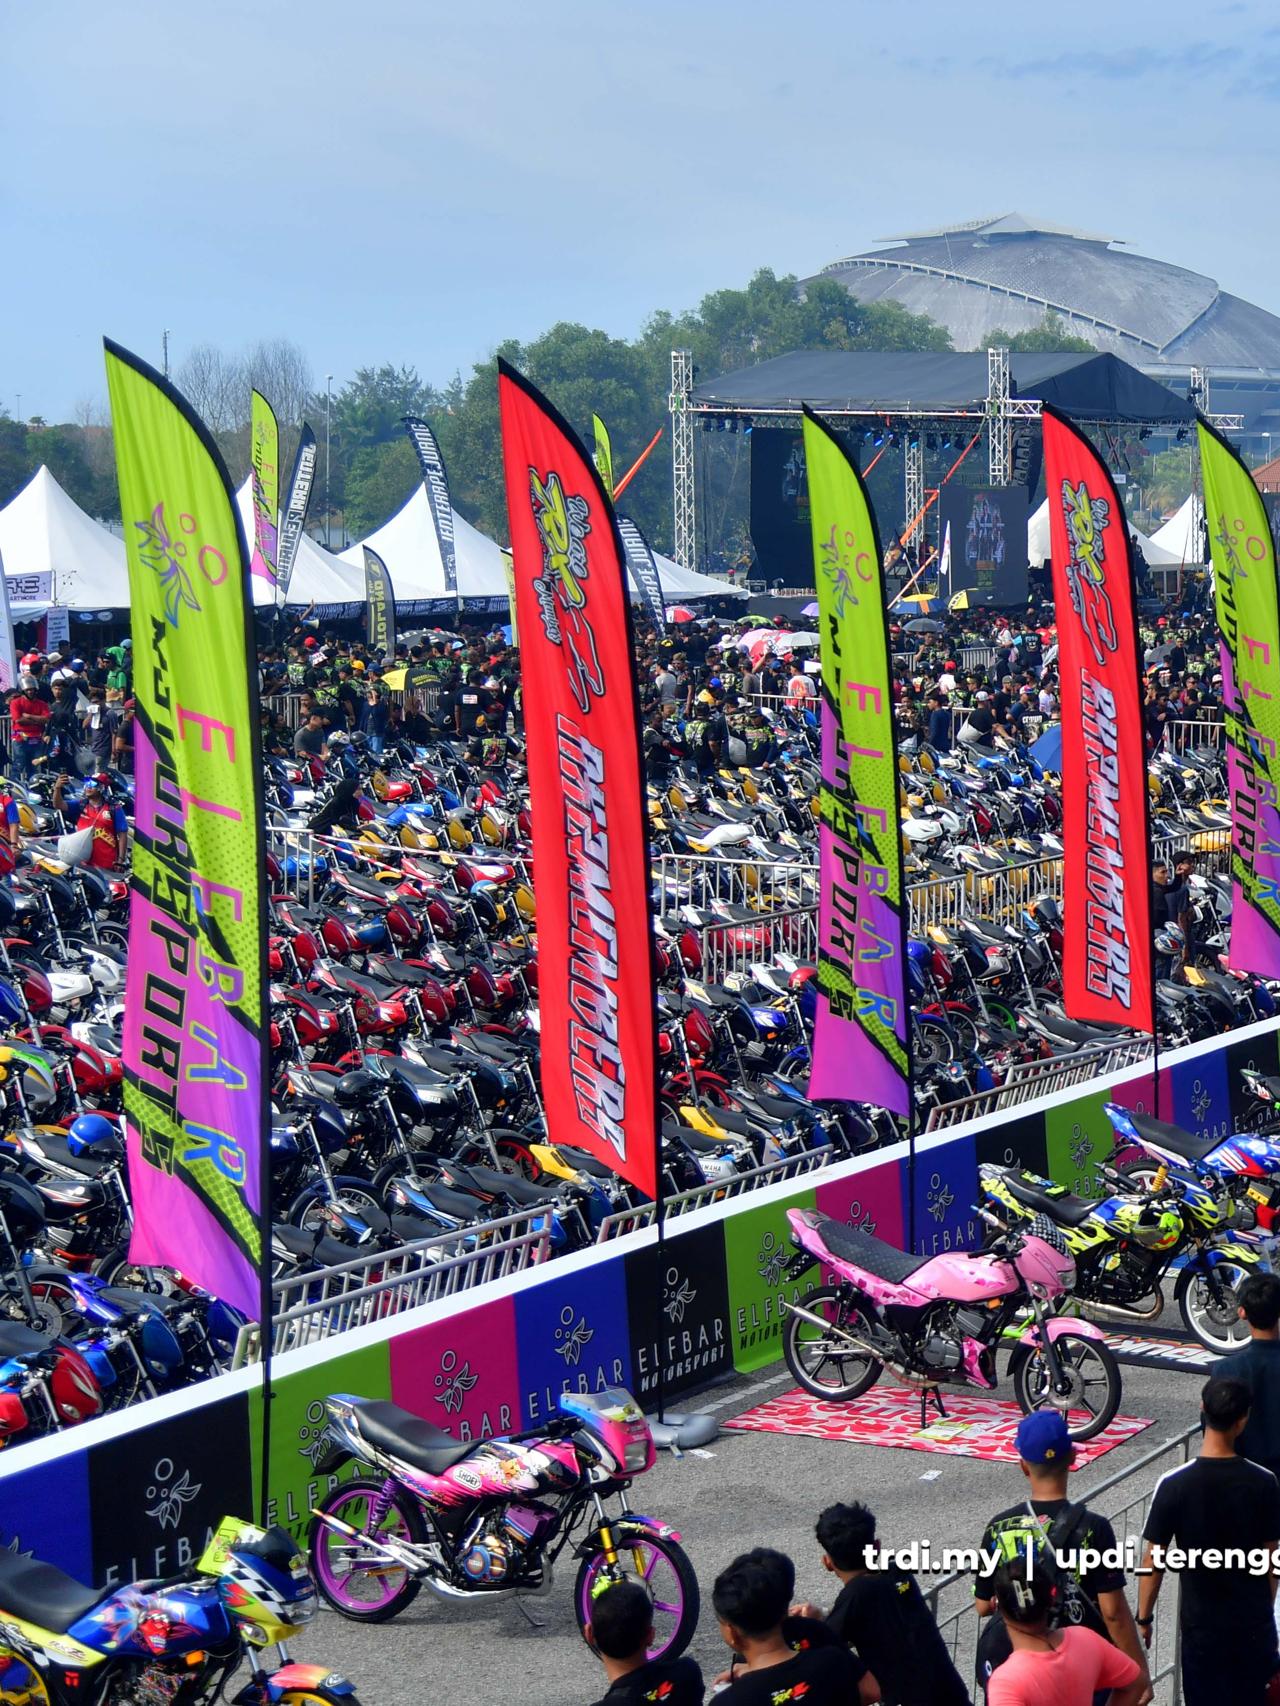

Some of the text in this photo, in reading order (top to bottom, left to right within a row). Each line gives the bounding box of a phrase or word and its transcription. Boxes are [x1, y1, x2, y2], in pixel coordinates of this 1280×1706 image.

[174, 703, 248, 1187] ELFBAR
[639, 1319, 724, 1373] ELFBAR
[528, 1358, 625, 1420] ELFBAR
[457, 1469, 480, 1486] SHOEI
